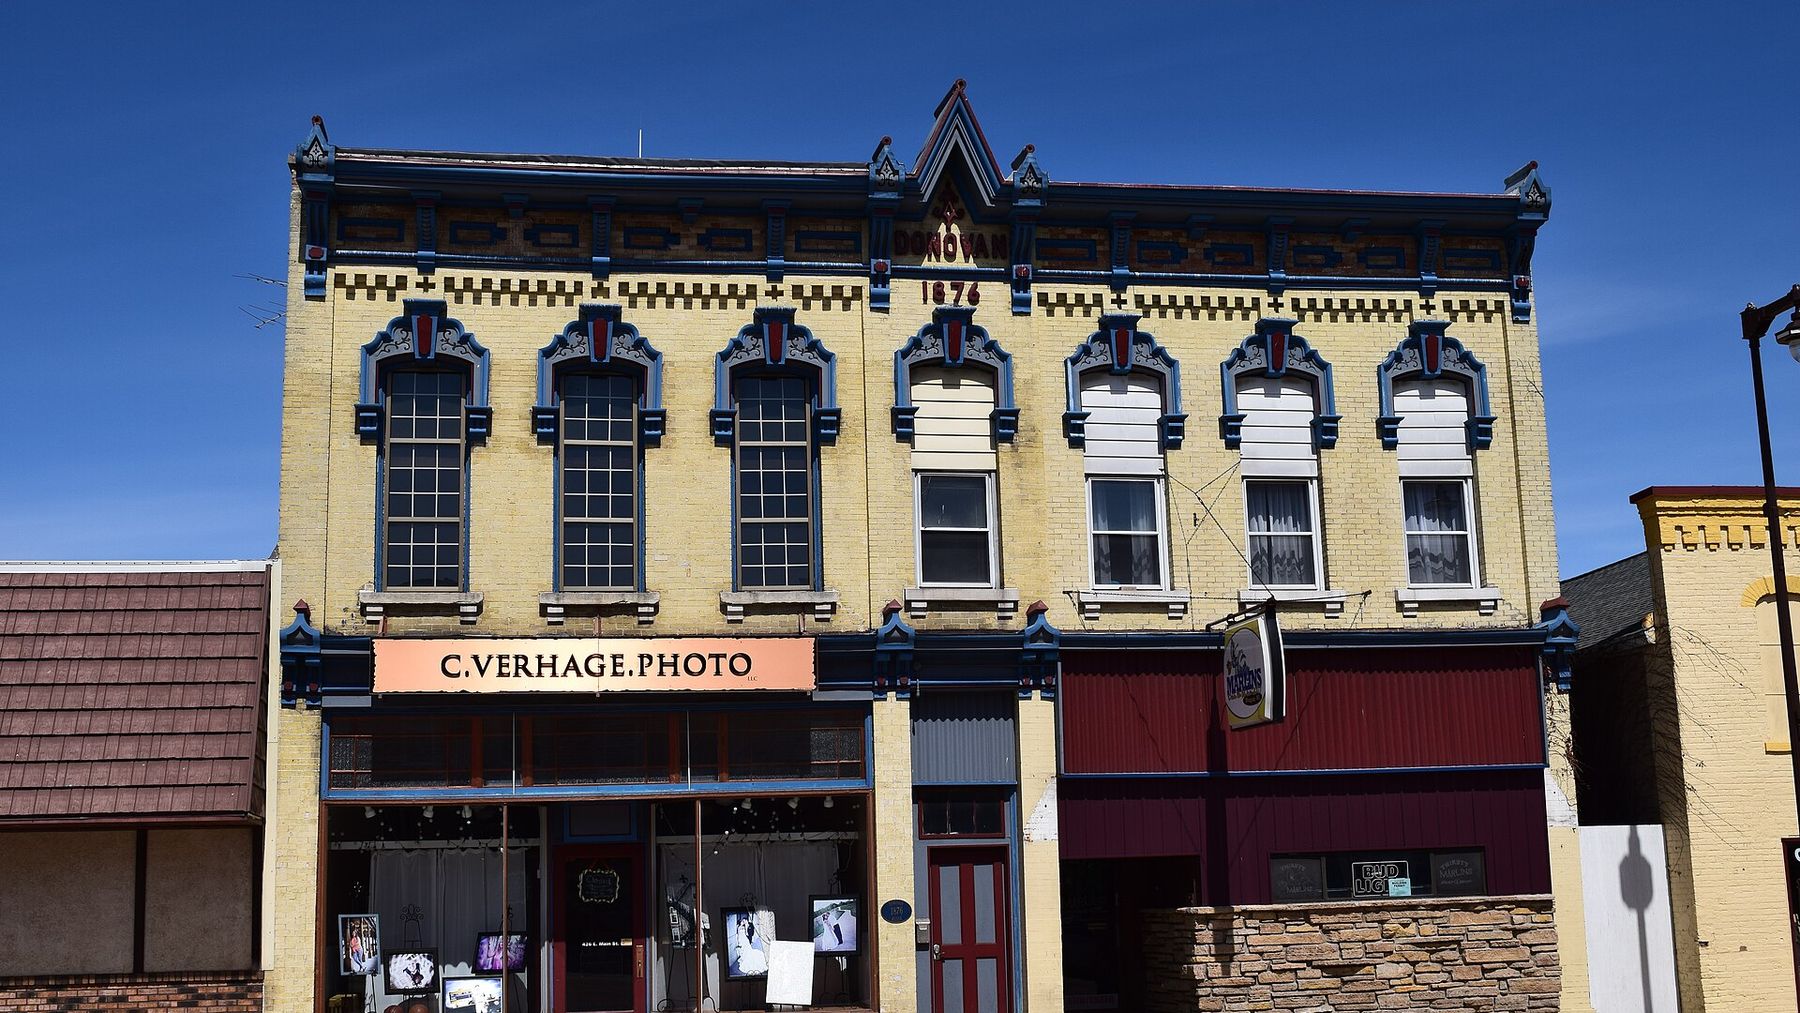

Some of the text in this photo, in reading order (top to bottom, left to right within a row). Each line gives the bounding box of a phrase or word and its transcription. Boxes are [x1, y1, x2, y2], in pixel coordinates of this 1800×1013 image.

[893, 230, 1008, 262] DONOVAN
[921, 280, 981, 306] 1876
[1361, 864, 1399, 879] BUD
[1355, 878, 1389, 893] LIG
